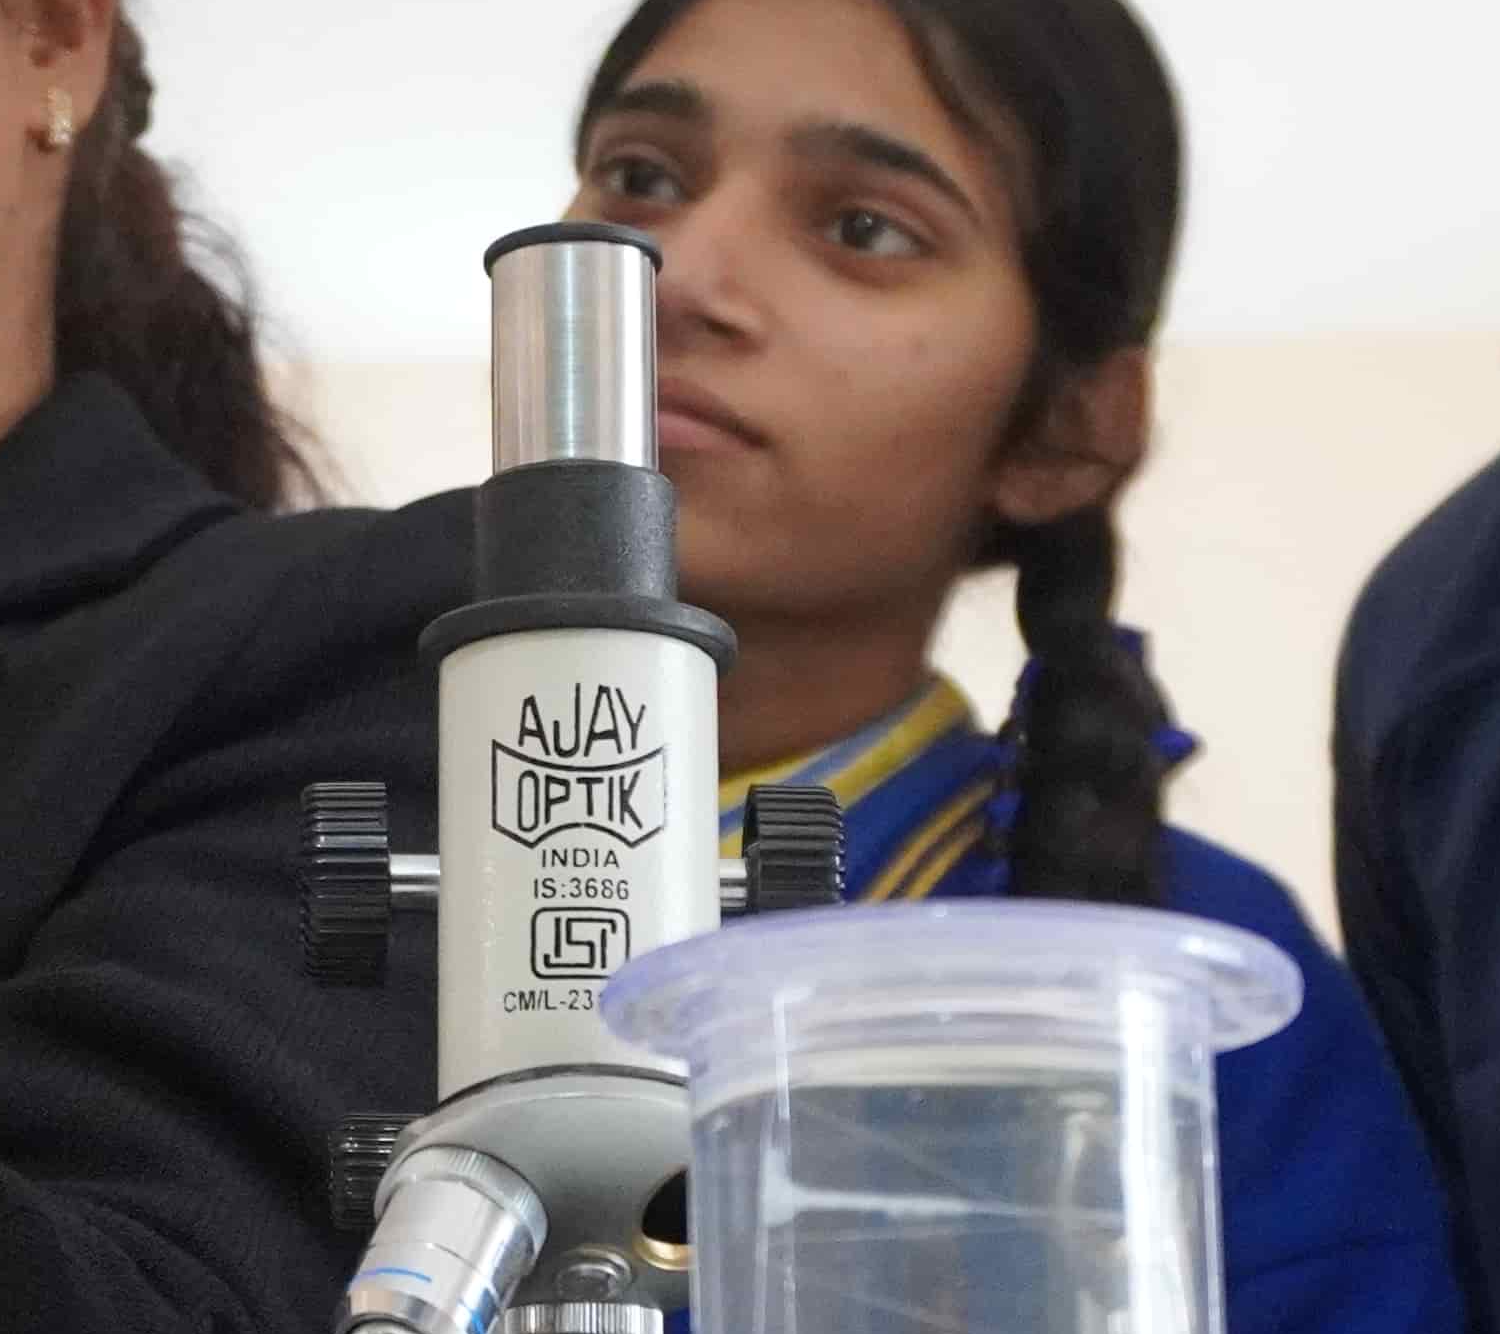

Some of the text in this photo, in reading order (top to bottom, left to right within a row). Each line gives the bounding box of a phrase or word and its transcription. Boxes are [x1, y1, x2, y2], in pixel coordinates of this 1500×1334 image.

[518, 683, 646, 757] AJAY
[518, 769, 643, 832] OPTIK
[541, 848, 620, 869] INDIA
[534, 878, 630, 901] IS:3686
[503, 988, 602, 1013] CM/L-23
